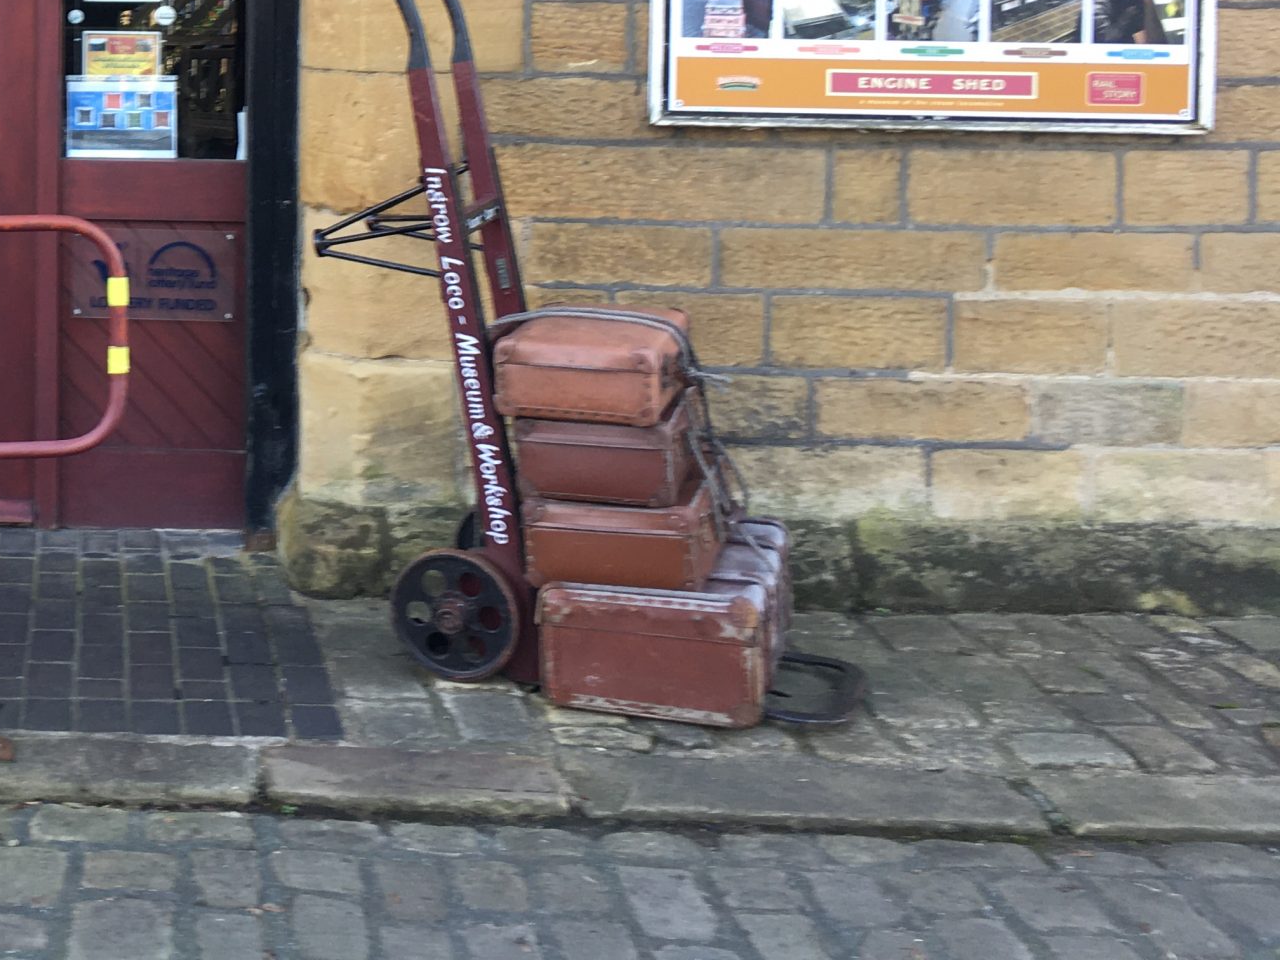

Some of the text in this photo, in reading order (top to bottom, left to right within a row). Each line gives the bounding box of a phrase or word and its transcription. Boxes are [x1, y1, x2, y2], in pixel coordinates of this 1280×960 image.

[857, 76, 1007, 91] ENGINE SHED
[424, 167, 454, 244] Ingrow
[440, 256, 465, 310] Loco
[455, 332, 487, 419] Museum
[471, 422, 495, 440] &
[475, 443, 513, 545] Workshop
